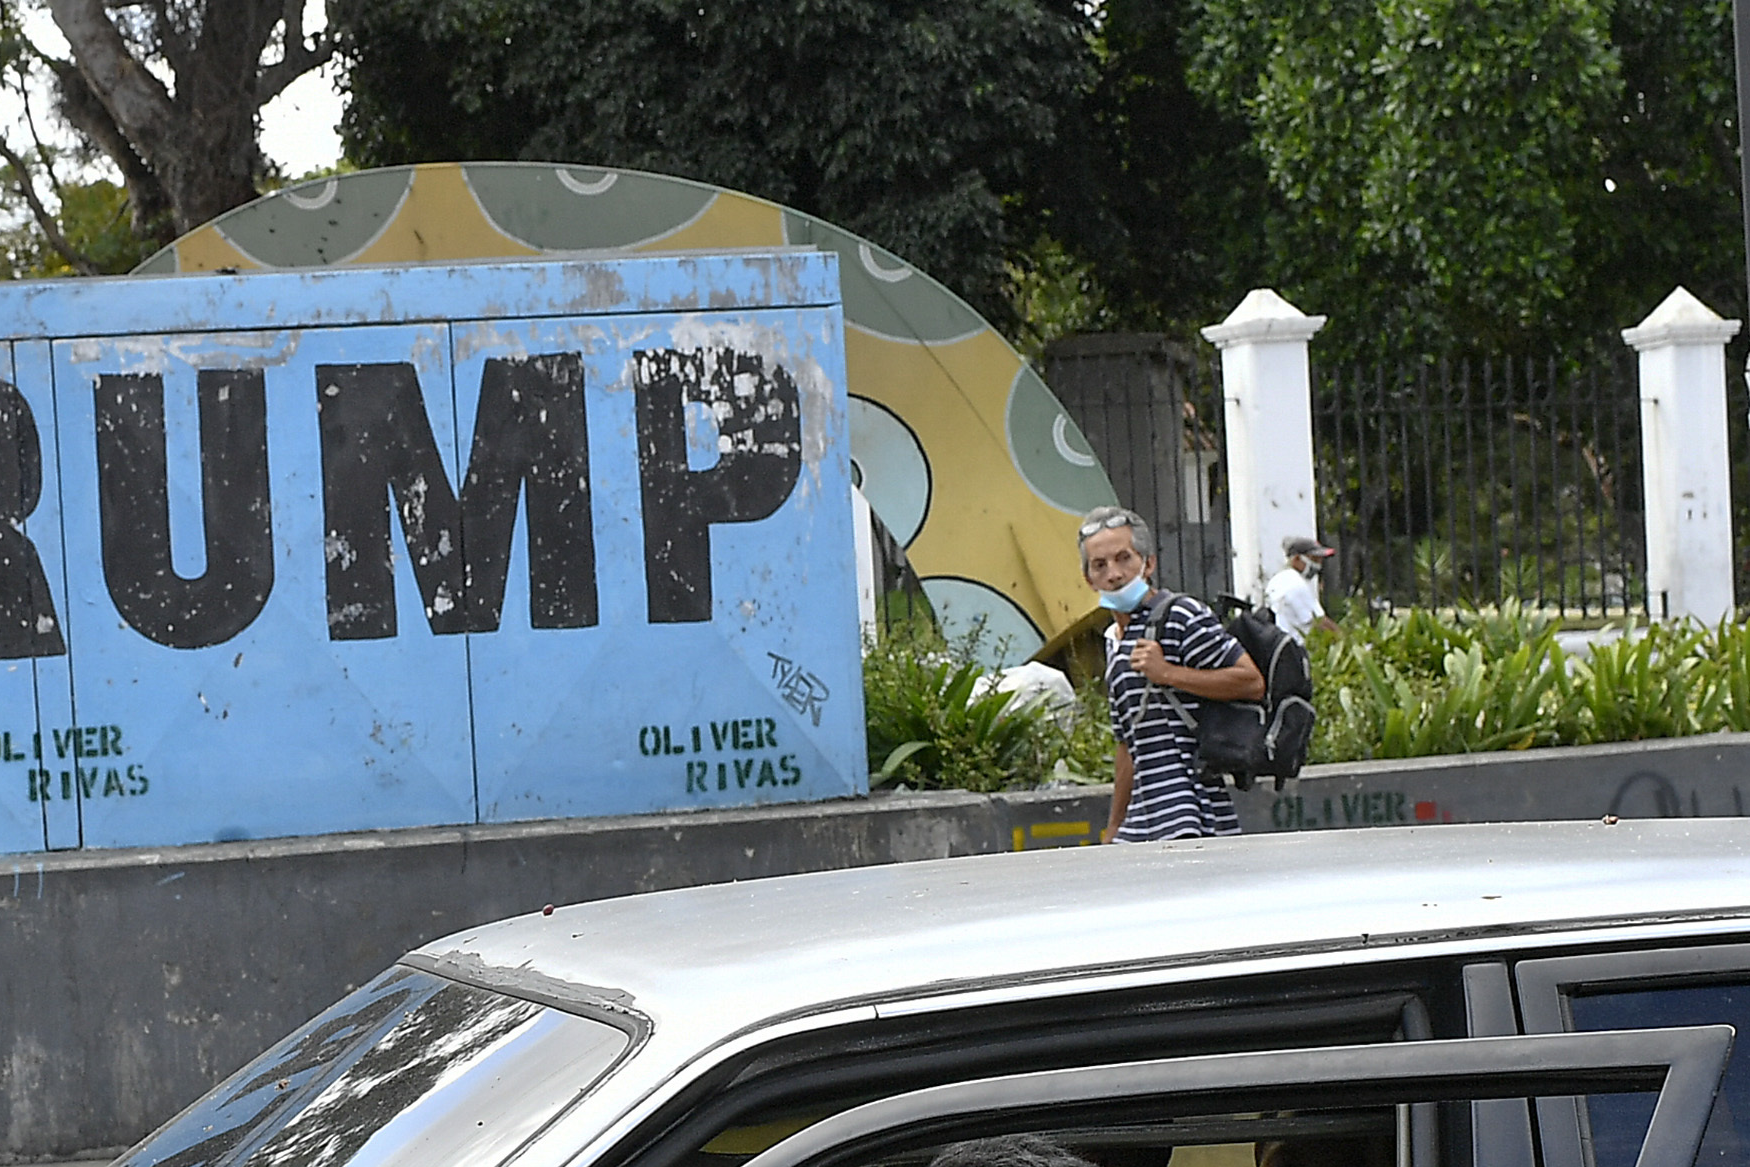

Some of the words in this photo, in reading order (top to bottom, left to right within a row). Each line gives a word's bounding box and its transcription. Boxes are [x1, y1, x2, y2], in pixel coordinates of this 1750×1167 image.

[639, 717, 778, 756] OLIVER
[28, 764, 150, 802] RIVAS
[686, 754, 802, 794] RIVAS
[1270, 792, 1408, 828] OLIVER
